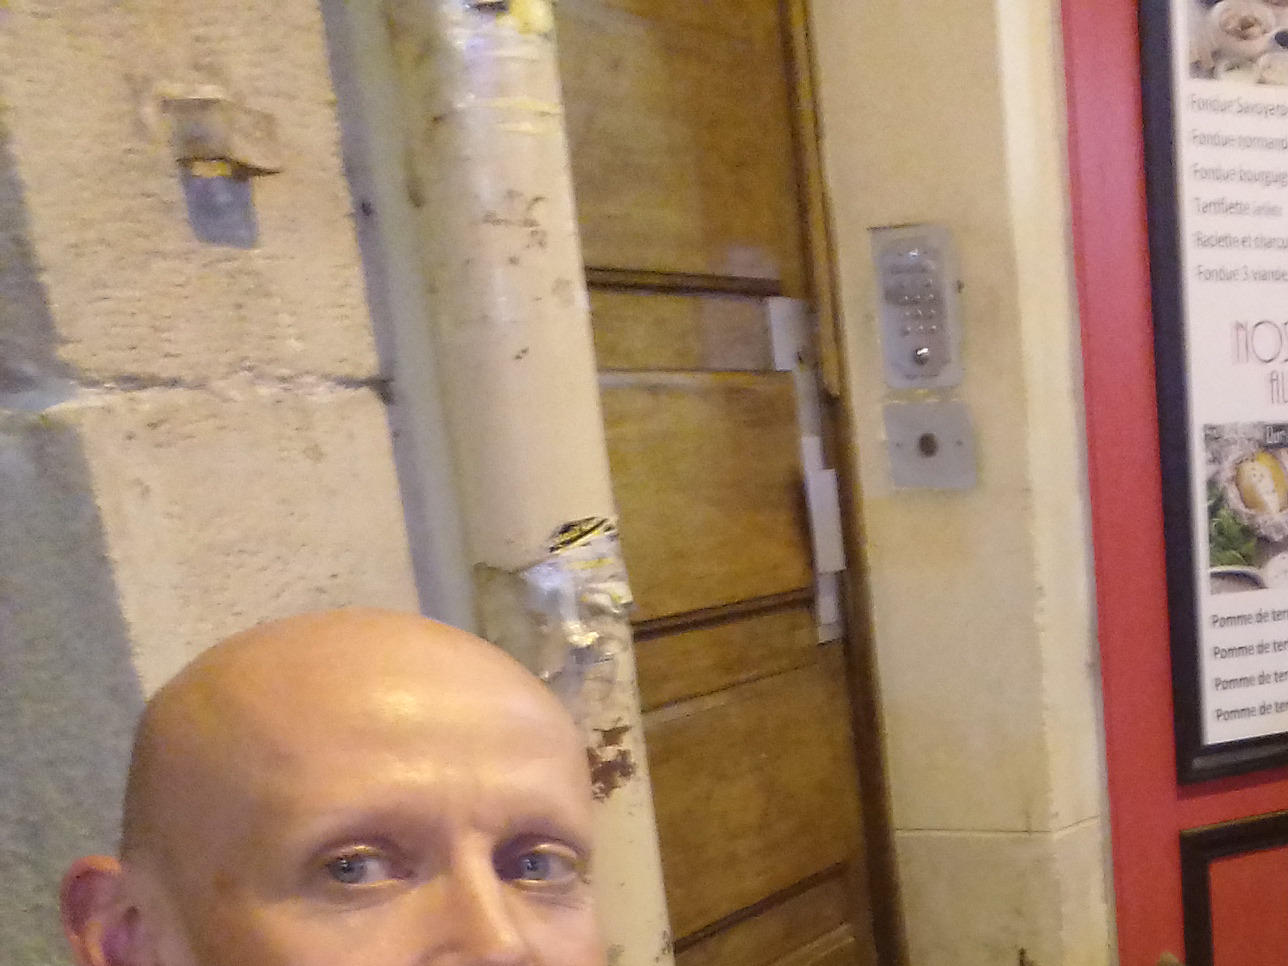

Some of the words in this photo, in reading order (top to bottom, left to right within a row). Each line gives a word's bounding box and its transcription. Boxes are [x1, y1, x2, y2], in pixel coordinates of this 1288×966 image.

[1211, 612, 1254, 629] Pomme
[1255, 608, 1270, 623] de
[1213, 644, 1255, 660] Pomme
[1257, 639, 1271, 654] de
[1214, 676, 1256, 692] Pomme
[1258, 671, 1272, 686] de
[1216, 707, 1257, 722] Pomme
[1259, 702, 1272, 716] de
